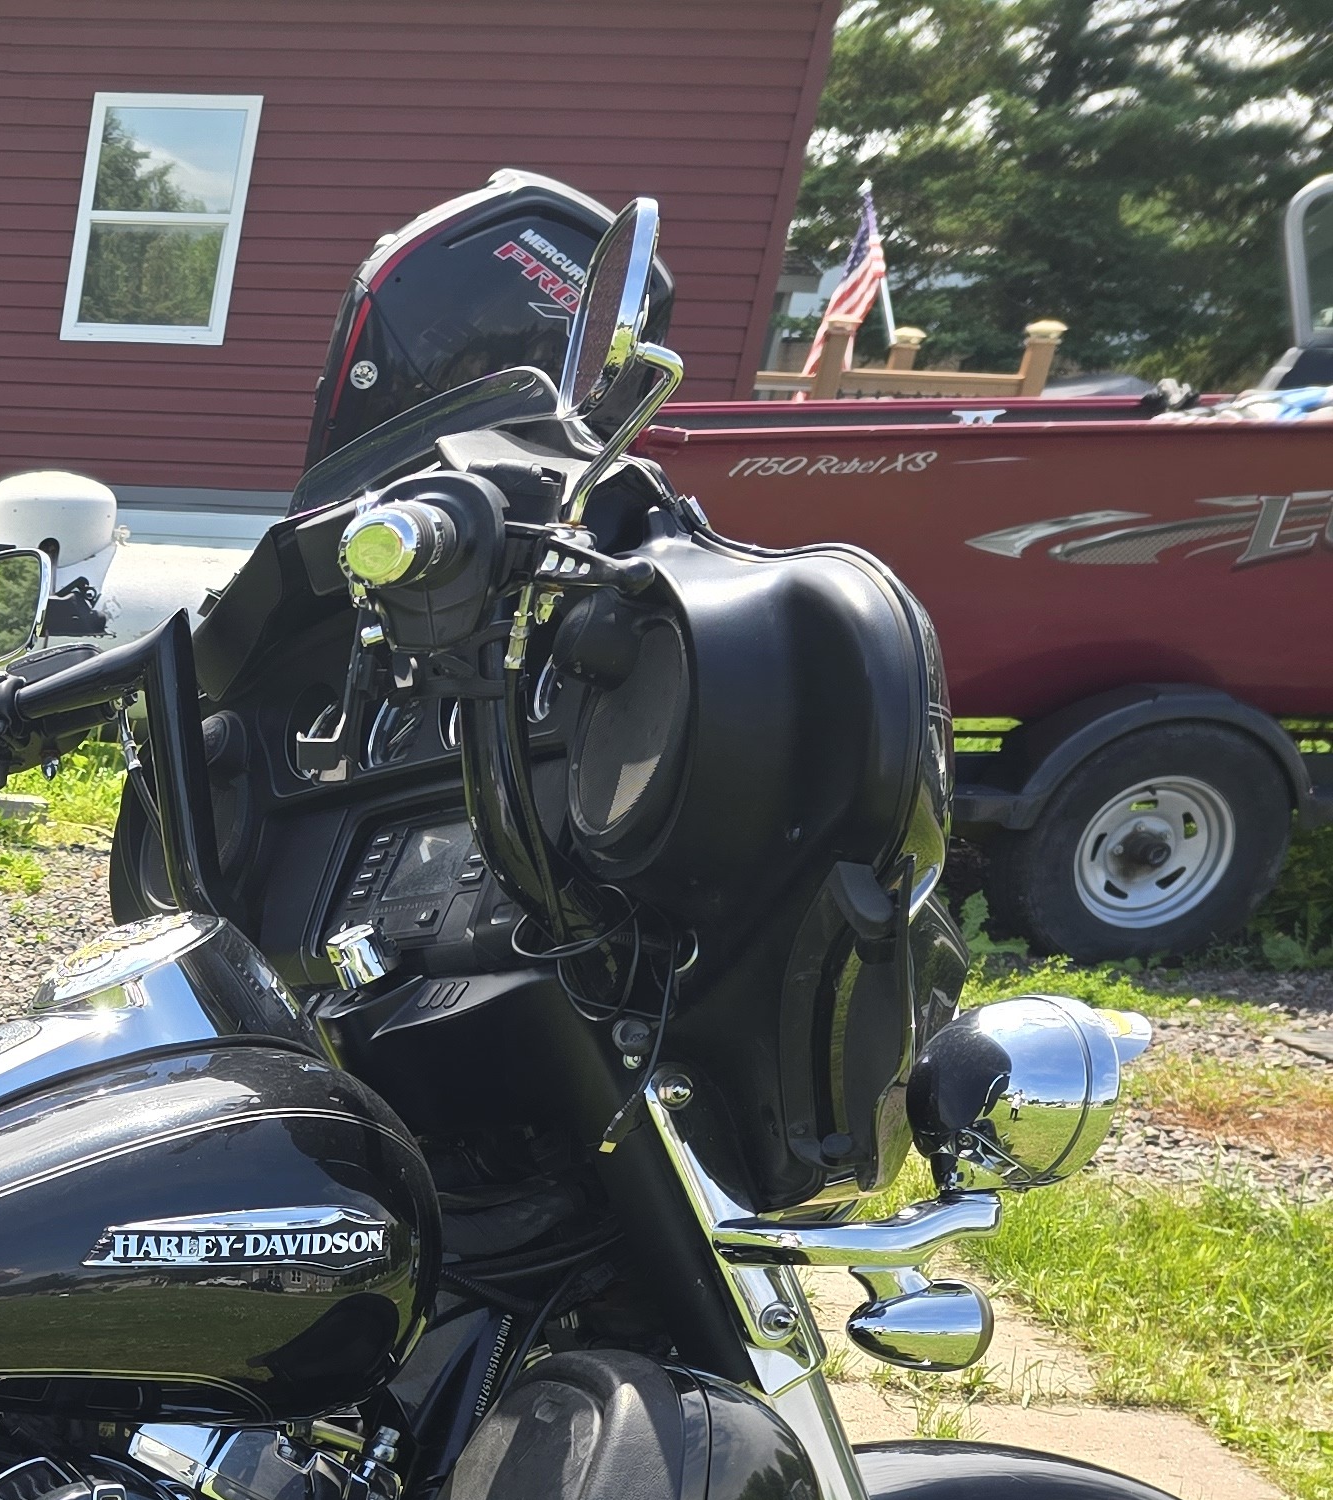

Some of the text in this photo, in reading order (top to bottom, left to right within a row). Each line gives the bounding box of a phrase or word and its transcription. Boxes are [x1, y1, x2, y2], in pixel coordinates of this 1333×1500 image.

[493, 241, 581, 314] PRO
[728, 451, 938, 478] 1750 Rebel XS
[113, 1229, 385, 1259] HARLEY-DAVIDSON
